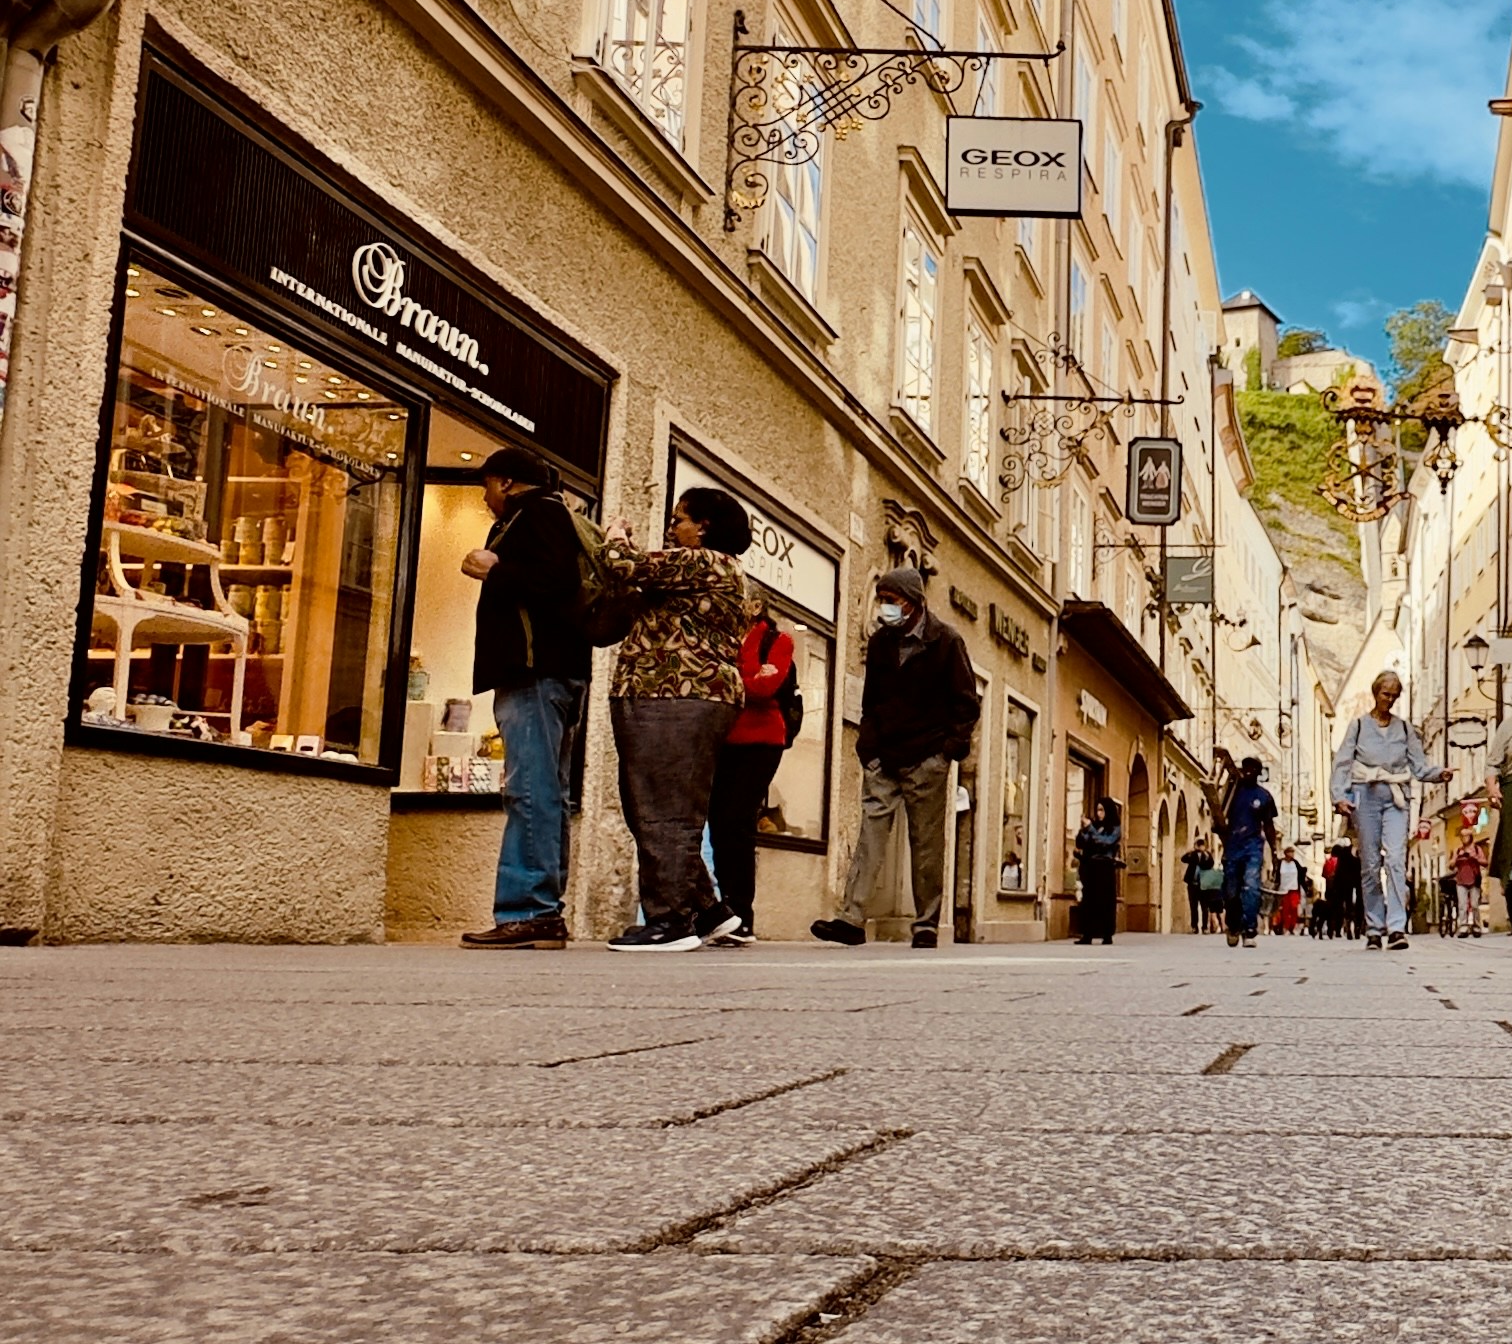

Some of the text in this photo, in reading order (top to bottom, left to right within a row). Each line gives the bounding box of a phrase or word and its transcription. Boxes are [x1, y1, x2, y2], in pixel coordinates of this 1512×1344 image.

[960, 167, 1067, 181] RESPIRA
[961, 148, 1067, 168] GEOX
[270, 266, 388, 346] INTERNATIONALE
[151, 367, 246, 418] INTERNATIONALE
[749, 513, 795, 569] EOX
[748, 548, 794, 593] SPIRA
